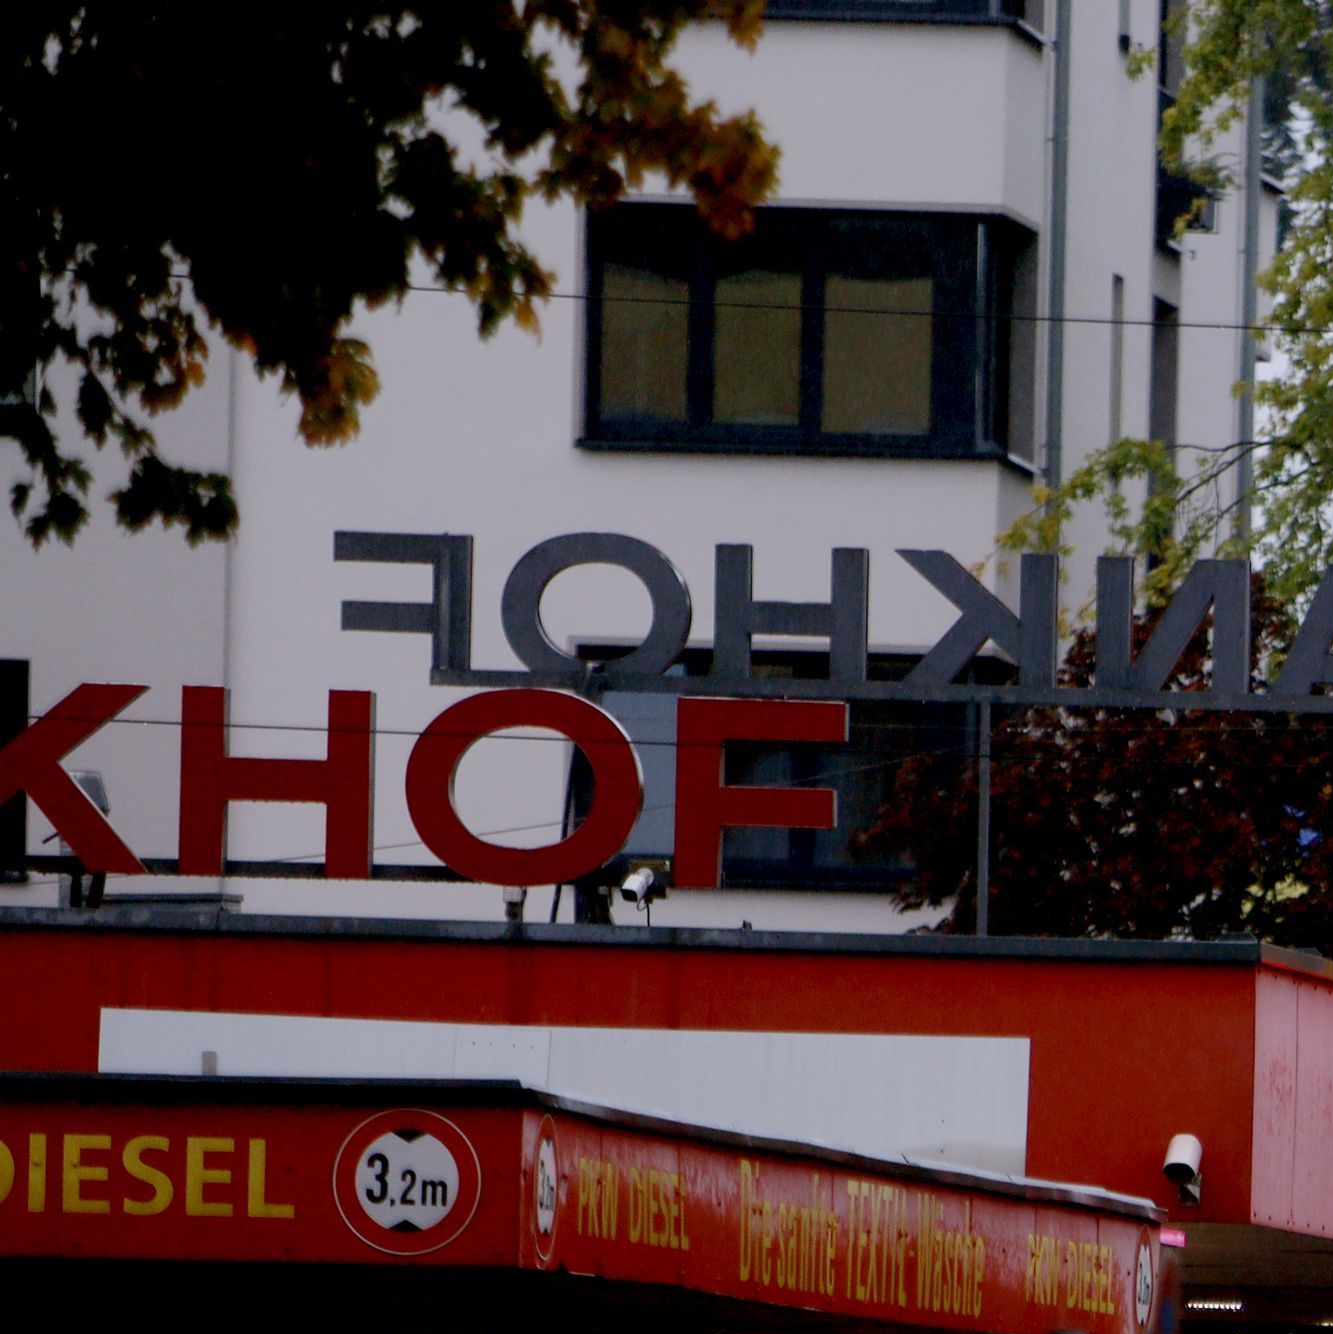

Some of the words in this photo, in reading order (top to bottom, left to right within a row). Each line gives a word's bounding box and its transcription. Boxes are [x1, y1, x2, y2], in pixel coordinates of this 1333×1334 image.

[0, 1133, 295, 1218] IESEL
[577, 1157, 621, 1241] PKW
[629, 1167, 690, 1250] DIESEL
[739, 1159, 772, 1287] Die
[777, 1173, 838, 1296] sanfte
[1066, 1241, 1115, 1315] DIESEL
